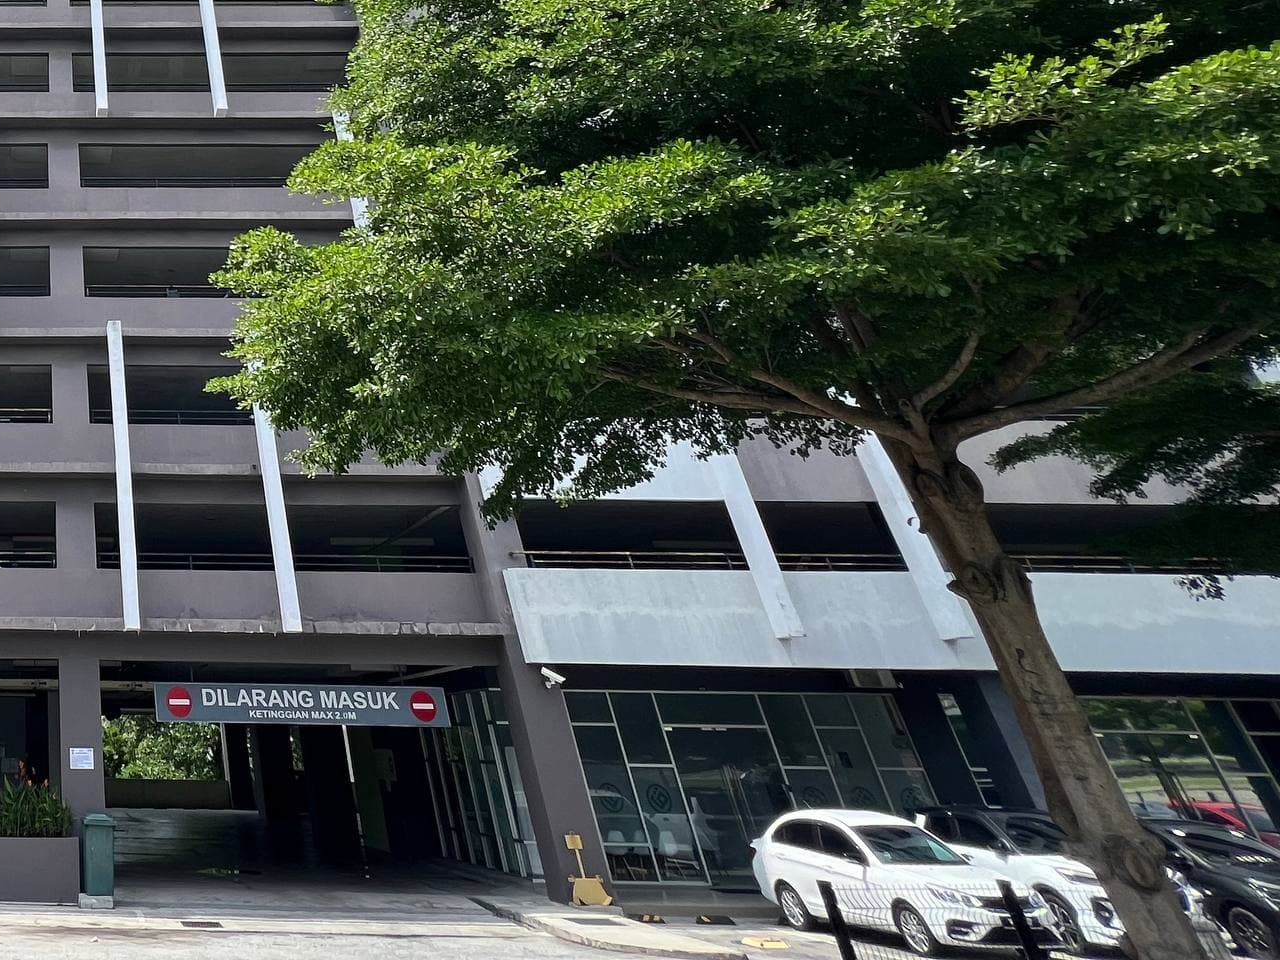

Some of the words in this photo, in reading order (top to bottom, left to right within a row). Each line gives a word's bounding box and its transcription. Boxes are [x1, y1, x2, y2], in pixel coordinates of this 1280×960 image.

[201, 688, 314, 708] DILARANG
[320, 690, 400, 710] MASUK
[249, 709, 308, 719] KETINGGIAN
[311, 711, 333, 720] MAX
[335, 711, 357, 720] 2.0M
